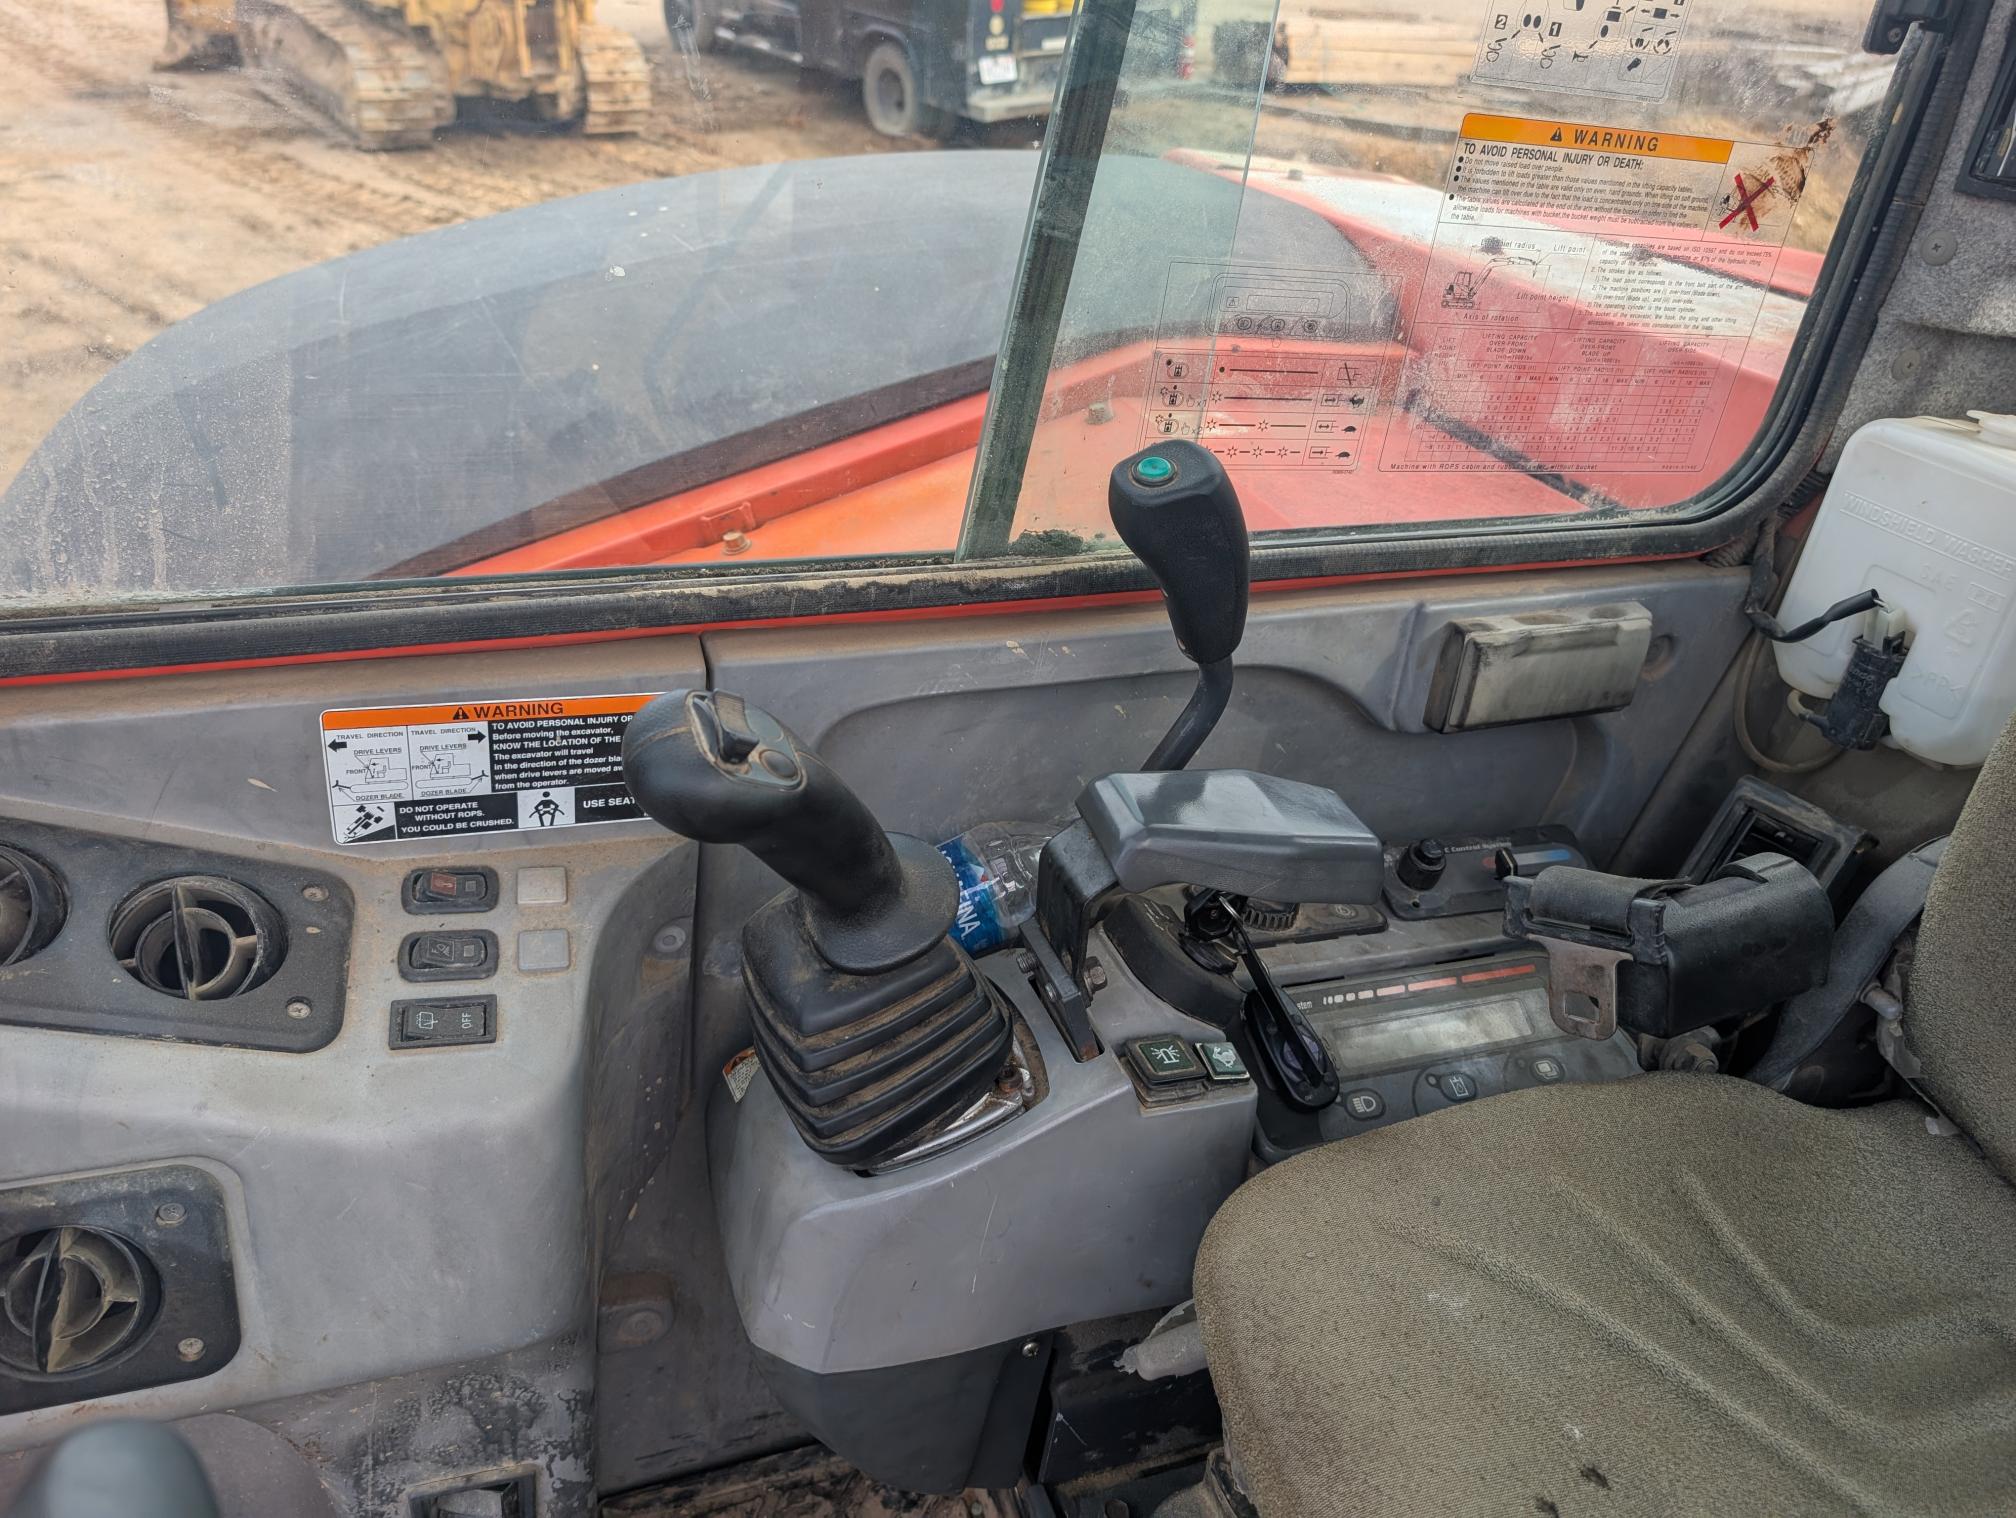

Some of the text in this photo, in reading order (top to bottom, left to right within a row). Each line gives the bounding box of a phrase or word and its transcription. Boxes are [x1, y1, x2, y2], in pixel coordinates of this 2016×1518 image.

[1571, 128, 1660, 151] WARNING
[1462, 142, 1645, 170] TO AVOID PERSONAL INJURY OR DEATH:
[1518, 161, 1530, 169] load
[1543, 164, 1563, 173] people.
[1471, 177, 1490, 185] values
[1490, 179, 1519, 187] mentioned
[1572, 186, 1584, 194] only
[1473, 168, 1499, 176] forbidden
[1531, 173, 1550, 182] greater
[1564, 175, 1579, 183] those
[1655, 183, 1677, 192] capacity
[1467, 186, 1490, 194] machine
[1514, 241, 1536, 249] radius
[1567, 245, 1586, 253] point
[1529, 293, 1547, 301] point
[1547, 294, 1569, 302] height
[473, 702, 563, 718] WARNING
[506, 720, 534, 729] AVOID
[536, 717, 585, 727] PERSONAL
[587, 716, 618, 724] INJURY
[492, 732, 520, 740] Before
[522, 730, 553, 739] moving
[571, 726, 613, 736] excavator,
[493, 741, 521, 750] KNOW
[522, 740, 540, 748] THE
[543, 737, 587, 747] LOCATION
[603, 735, 621, 743] THE
[493, 752, 509, 760] The
[511, 750, 551, 759] excavator
[570, 747, 593, 755] travel
[519, 759, 556, 768] direction
[583, 756, 606, 764] dozer
[494, 771, 517, 779] when
[519, 770, 540, 778] drive
[542, 768, 567, 776] levers
[584, 765, 611, 773] moved
[531, 778, 569, 788] operator.
[399, 806, 413, 814] DO
[436, 801, 478, 811] OPERATE
[583, 798, 605, 808] USE
[414, 810, 484, 821] WITHOUT ROPS.
[401, 818, 514, 833] YOU COULD BE CRUSHED.
[1296, 1000, 1313, 1010] stem
[461, 1012, 473, 1029] OFF
